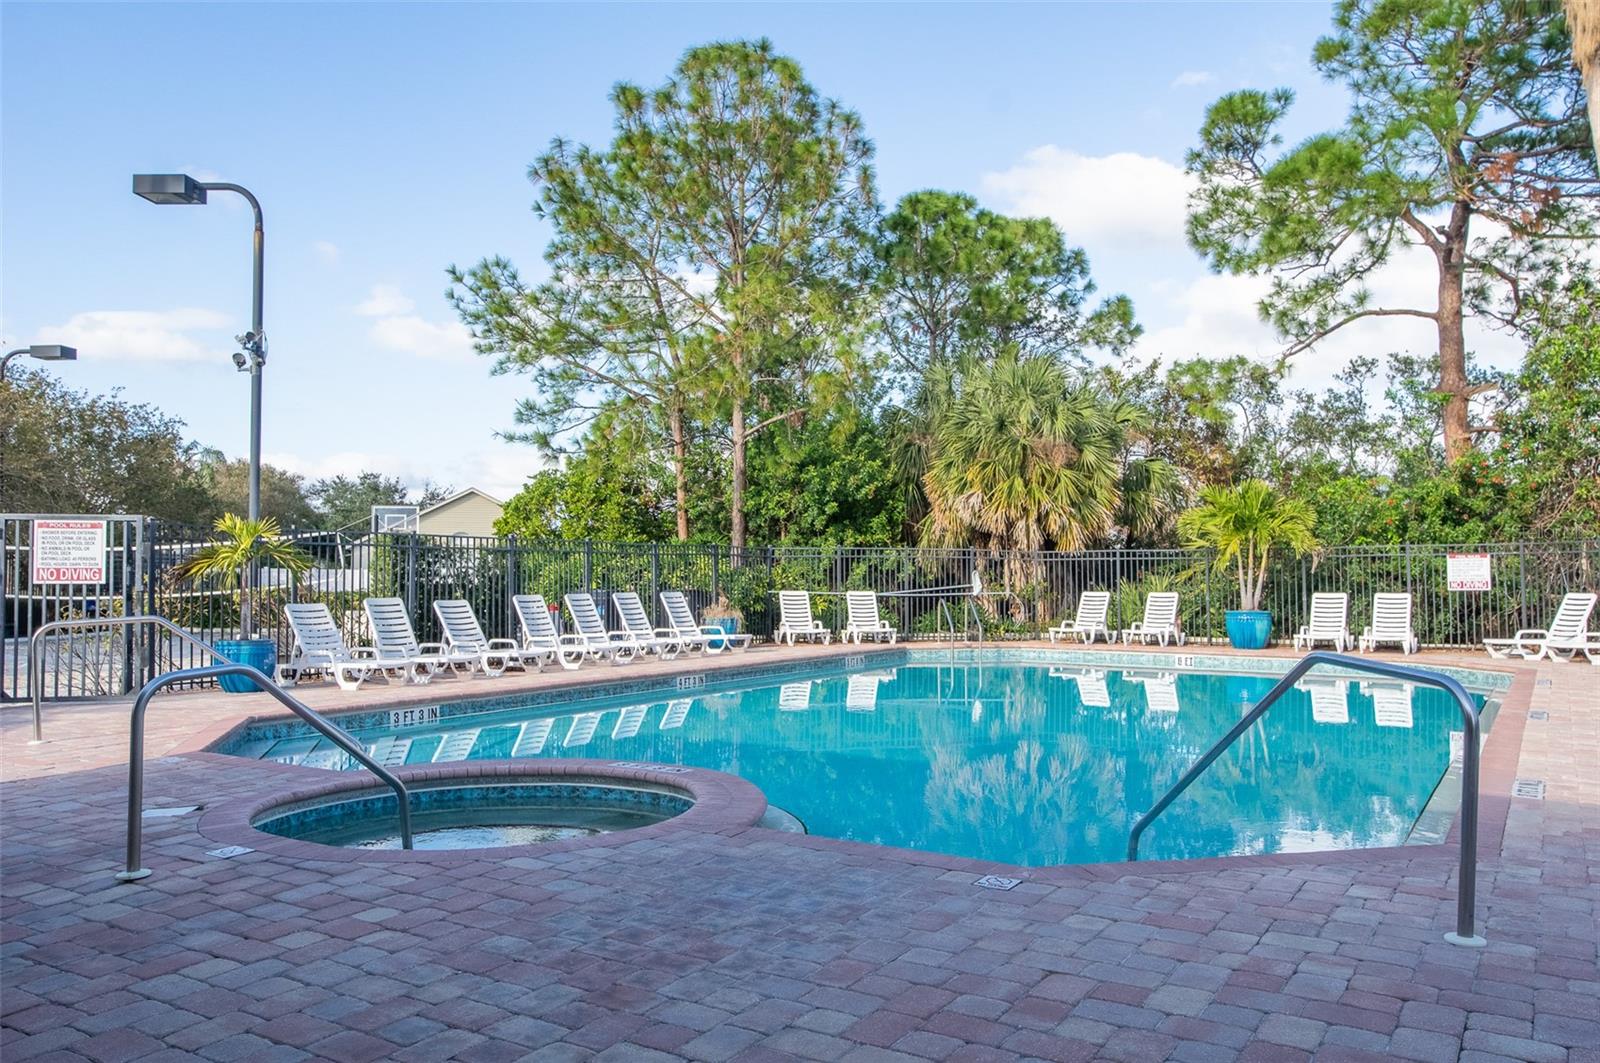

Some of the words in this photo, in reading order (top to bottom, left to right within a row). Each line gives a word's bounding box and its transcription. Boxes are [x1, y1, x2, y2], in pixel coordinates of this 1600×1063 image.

[39, 568, 56, 580] NO
[60, 568, 100, 580] DIVING
[394, 712, 399, 723] 3
[419, 709, 424, 720] 3
[428, 707, 437, 719] IN
